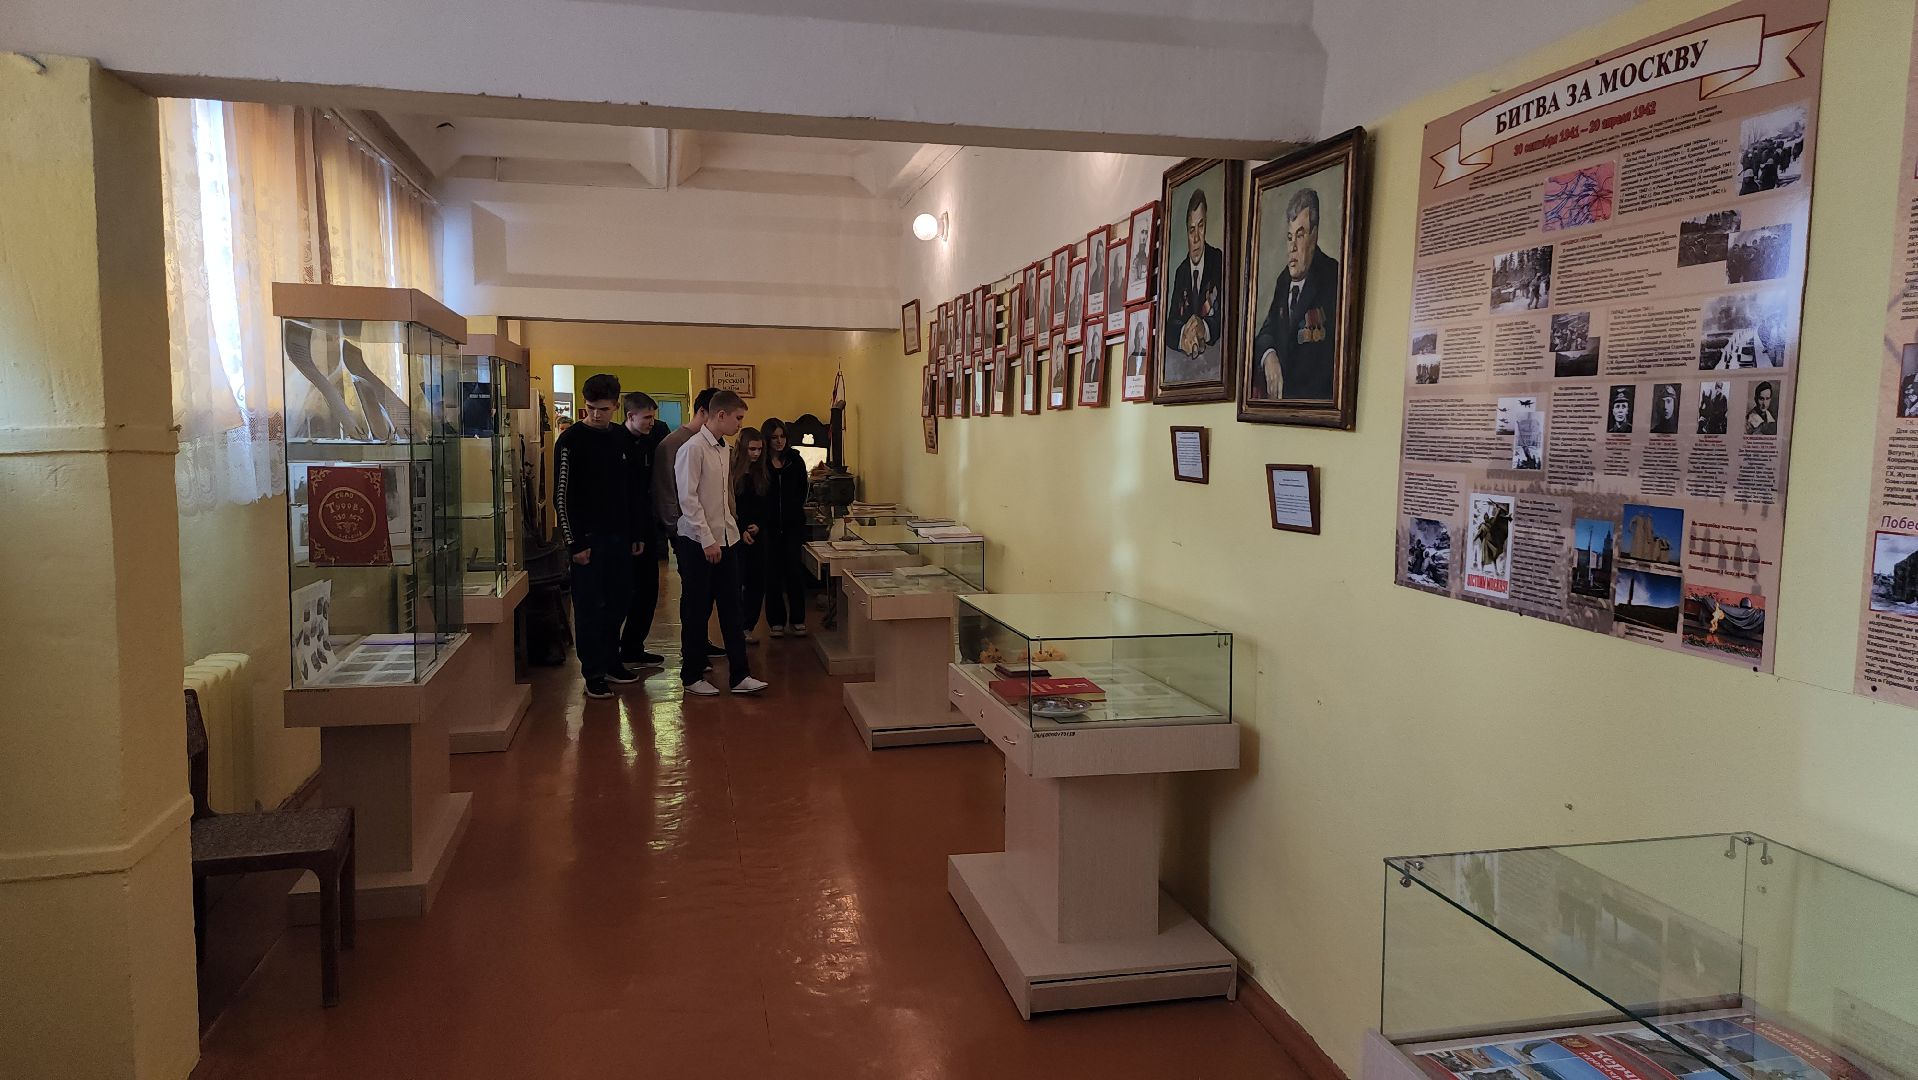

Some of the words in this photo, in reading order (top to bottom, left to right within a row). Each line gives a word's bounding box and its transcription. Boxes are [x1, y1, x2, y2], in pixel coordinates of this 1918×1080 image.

[1495, 98, 1561, 136] БИТВА
[1566, 83, 1592, 107] ЗА
[1598, 39, 1710, 91] МОСКВУ
[1559, 125, 1580, 141] 1941
[1632, 101, 1657, 121] 1942
